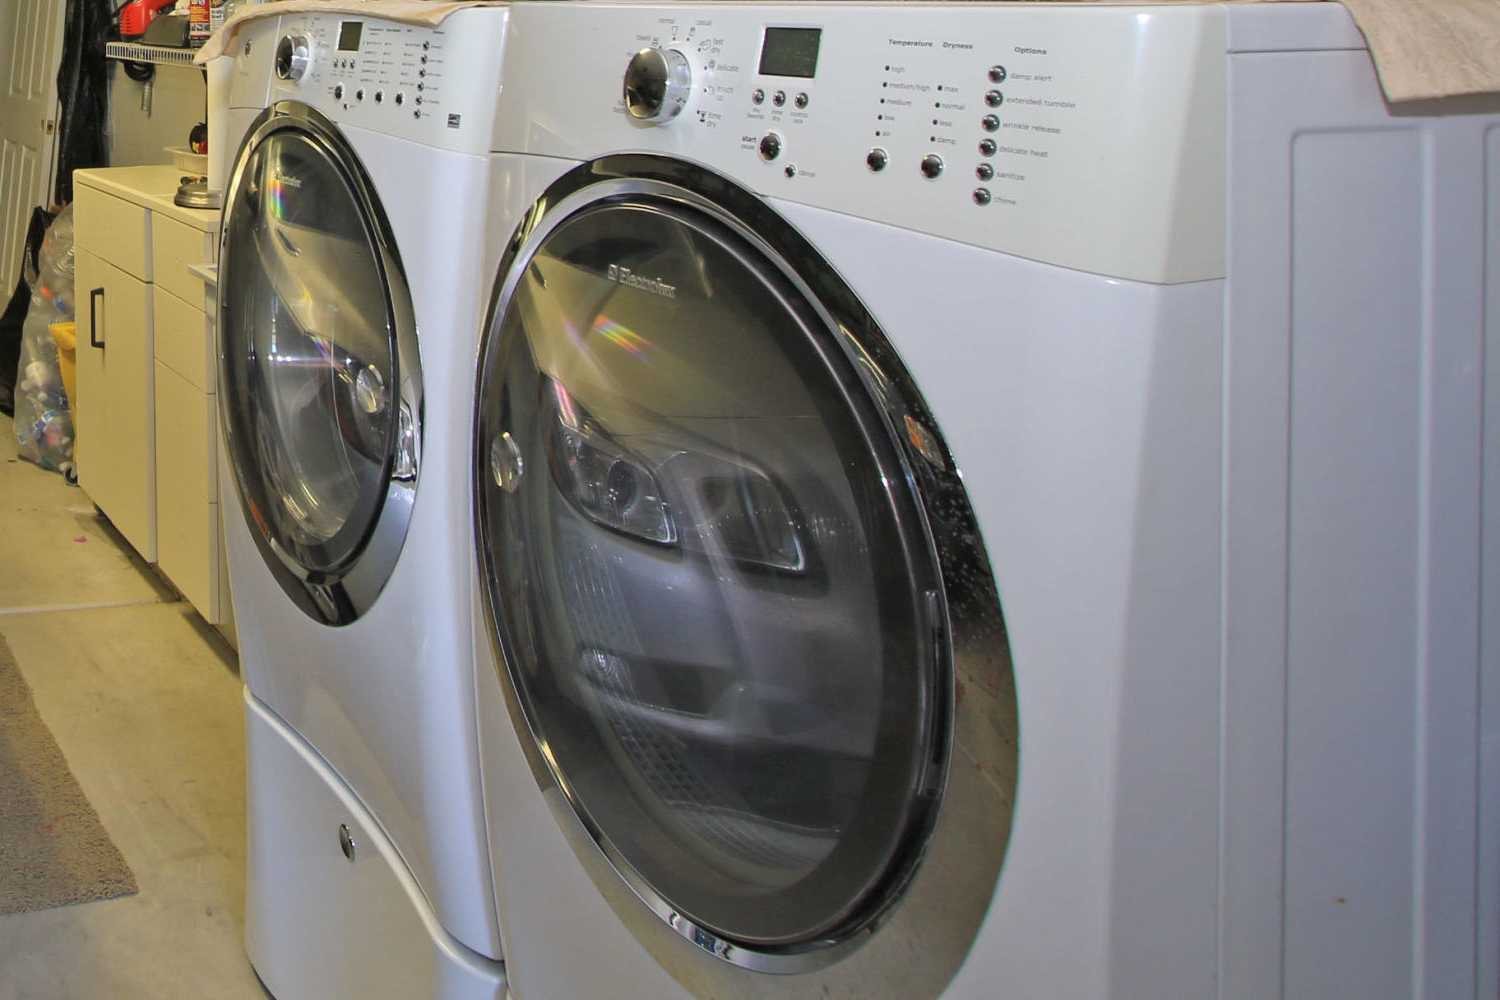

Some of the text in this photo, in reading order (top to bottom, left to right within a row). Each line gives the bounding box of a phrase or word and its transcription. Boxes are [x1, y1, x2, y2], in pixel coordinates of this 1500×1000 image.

[888, 38, 933, 48] Temperature
[942, 41, 974, 51] Dryness
[1014, 46, 1048, 56] Options
[1010, 72, 1053, 83] damp alert
[944, 85, 959, 94] max
[941, 102, 966, 111] normal
[1006, 96, 1077, 110] extended tumble
[939, 119, 953, 128] less
[1003, 120, 1062, 135] wrinkle release
[937, 136, 957, 146] damp
[999, 145, 1049, 159] delicate heat
[996, 169, 1026, 182] sanitize
[994, 196, 1017, 207] chime
[619, 267, 676, 299] Electrolux
